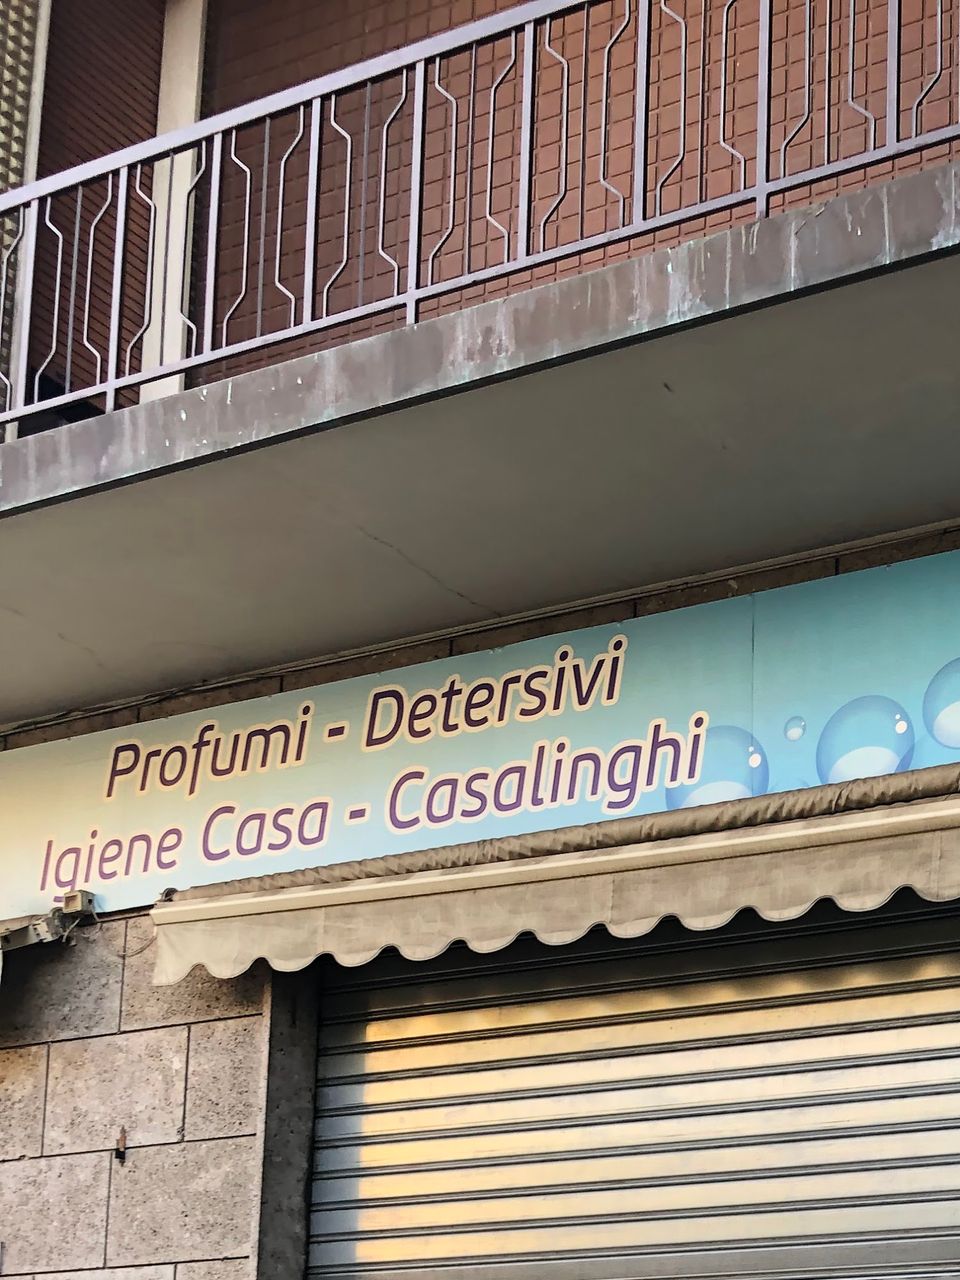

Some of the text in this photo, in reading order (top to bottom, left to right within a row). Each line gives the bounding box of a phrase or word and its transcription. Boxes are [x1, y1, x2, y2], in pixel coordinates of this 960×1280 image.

[106, 638, 626, 798] Profumi - Detersivi
[40, 716, 704, 903] Igiene Casa - Casalinghi
